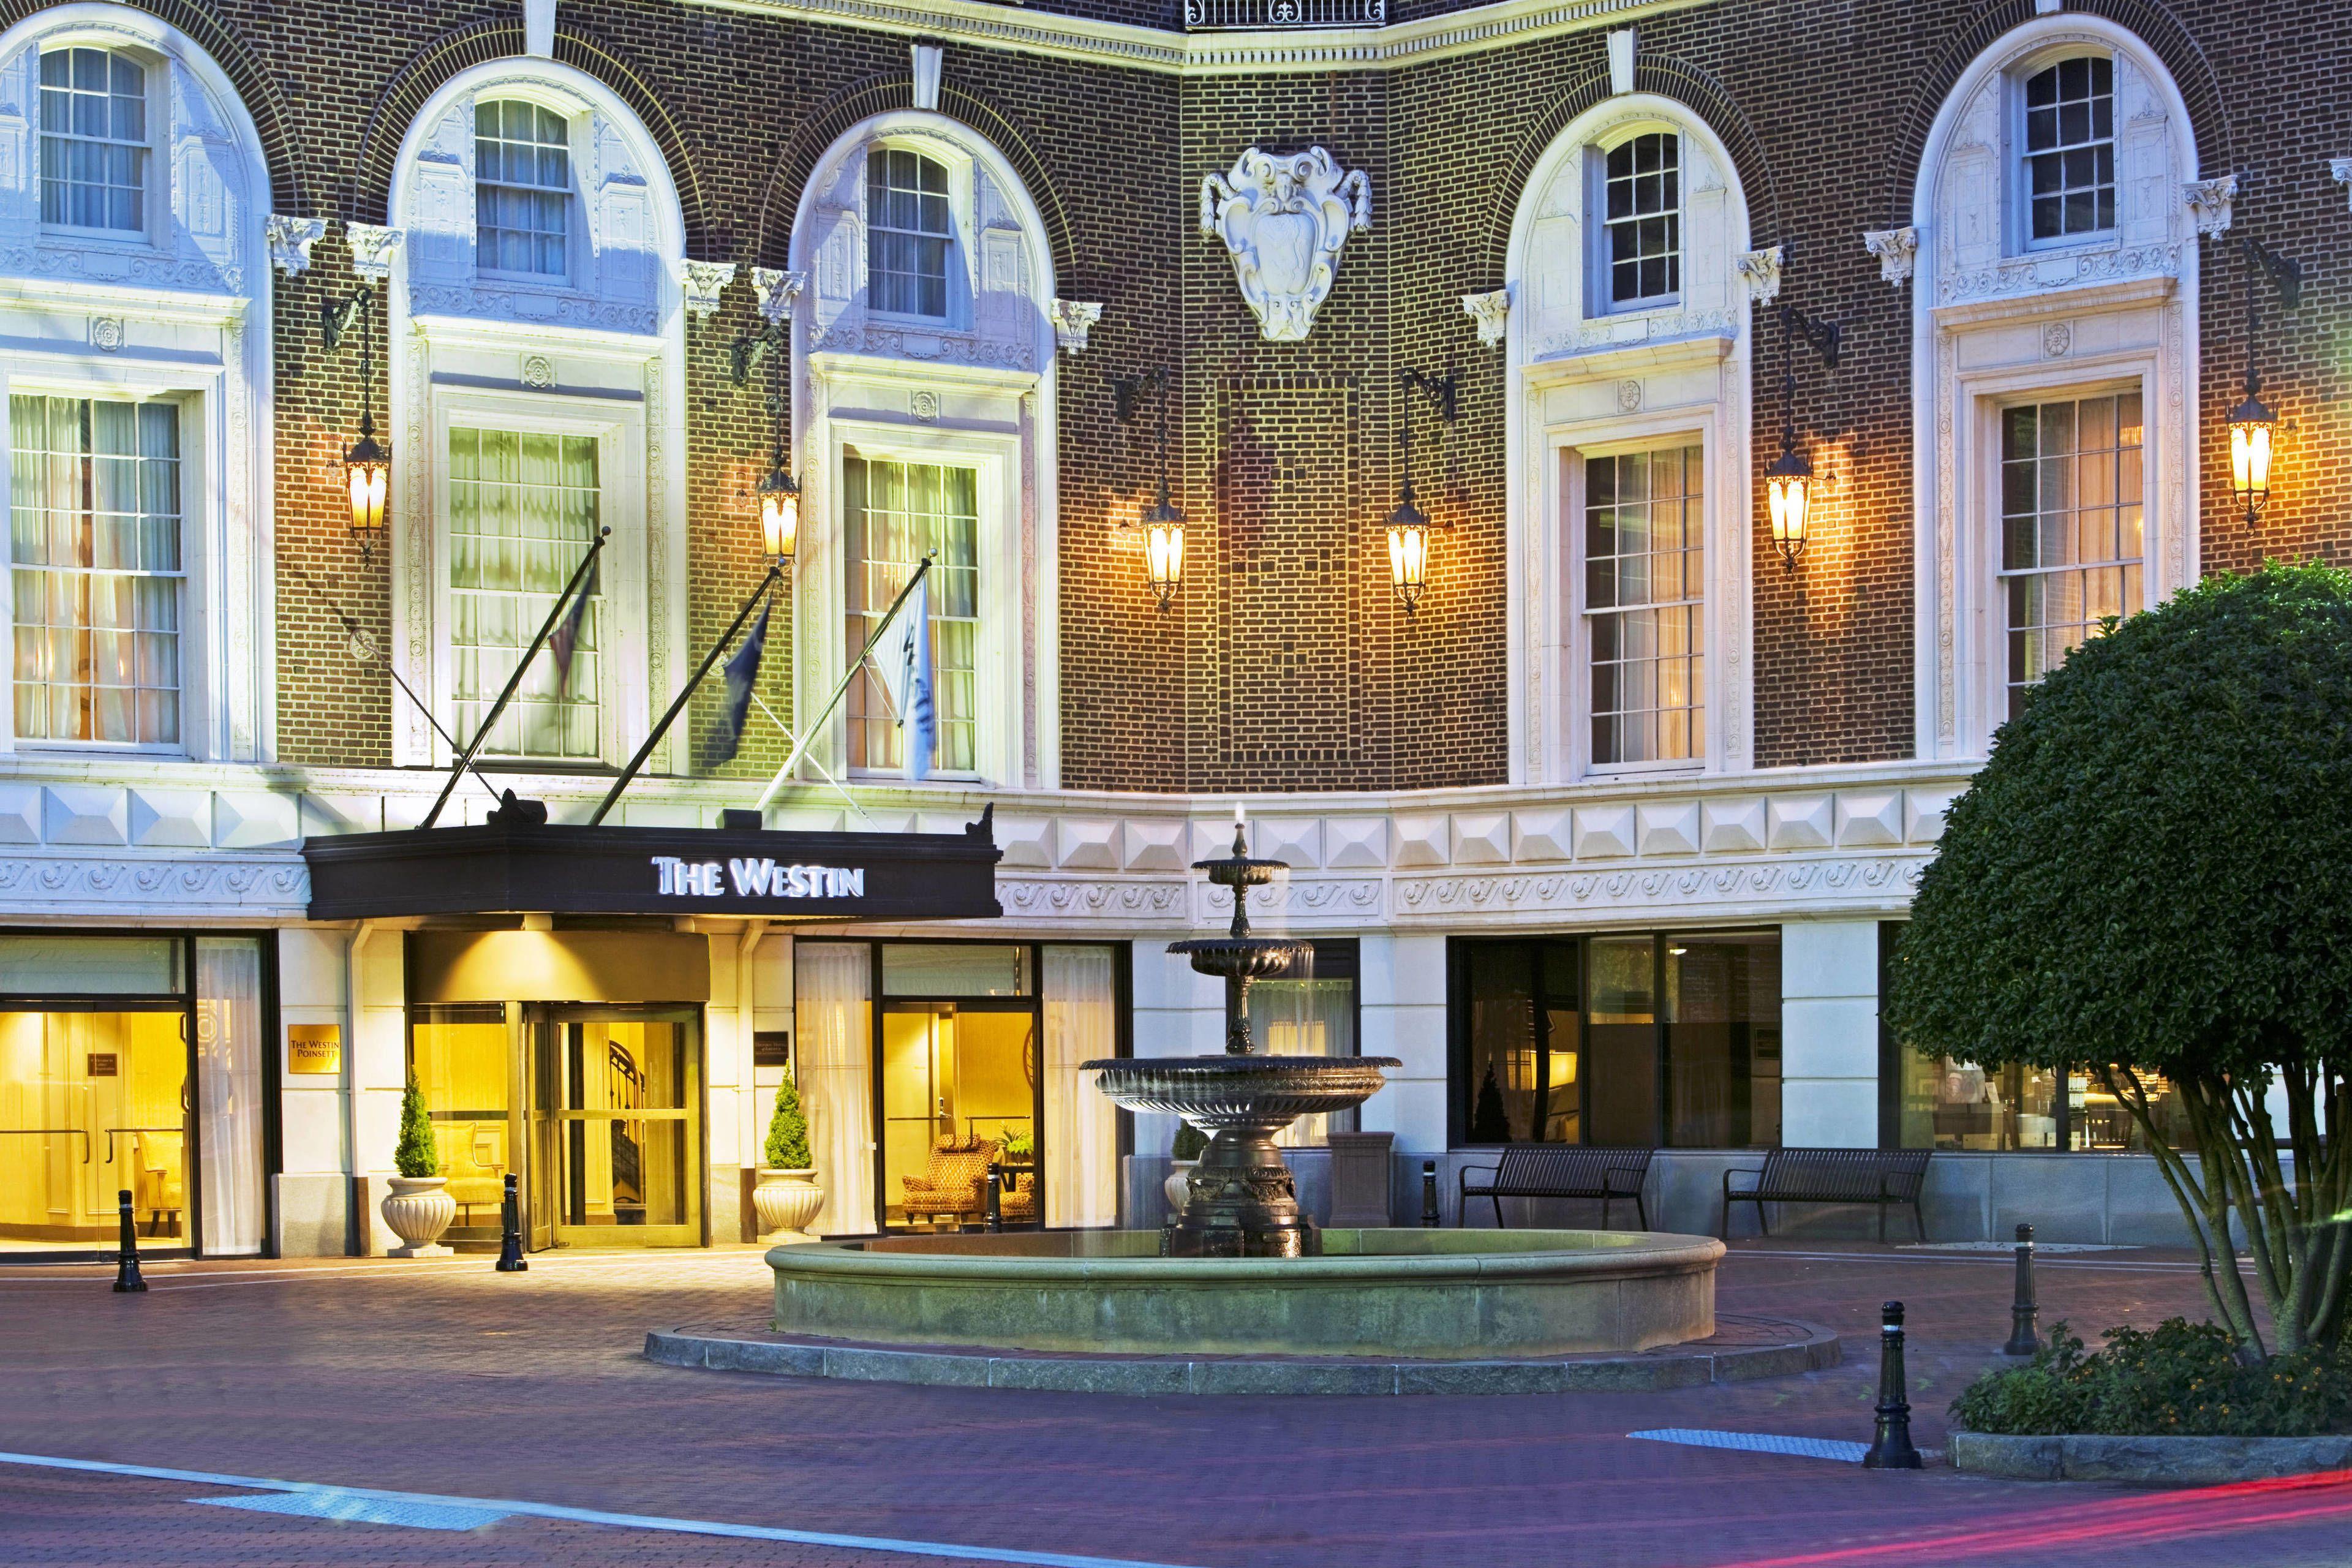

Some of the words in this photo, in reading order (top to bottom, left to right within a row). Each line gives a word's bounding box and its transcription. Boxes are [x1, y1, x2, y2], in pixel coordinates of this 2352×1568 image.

[650, 856, 725, 896] THE
[729, 858, 864, 897] WESTIN
[290, 1040, 307, 1049] THE
[309, 1040, 339, 1049] WESTIN
[297, 1049, 336, 1058] POINSETT
